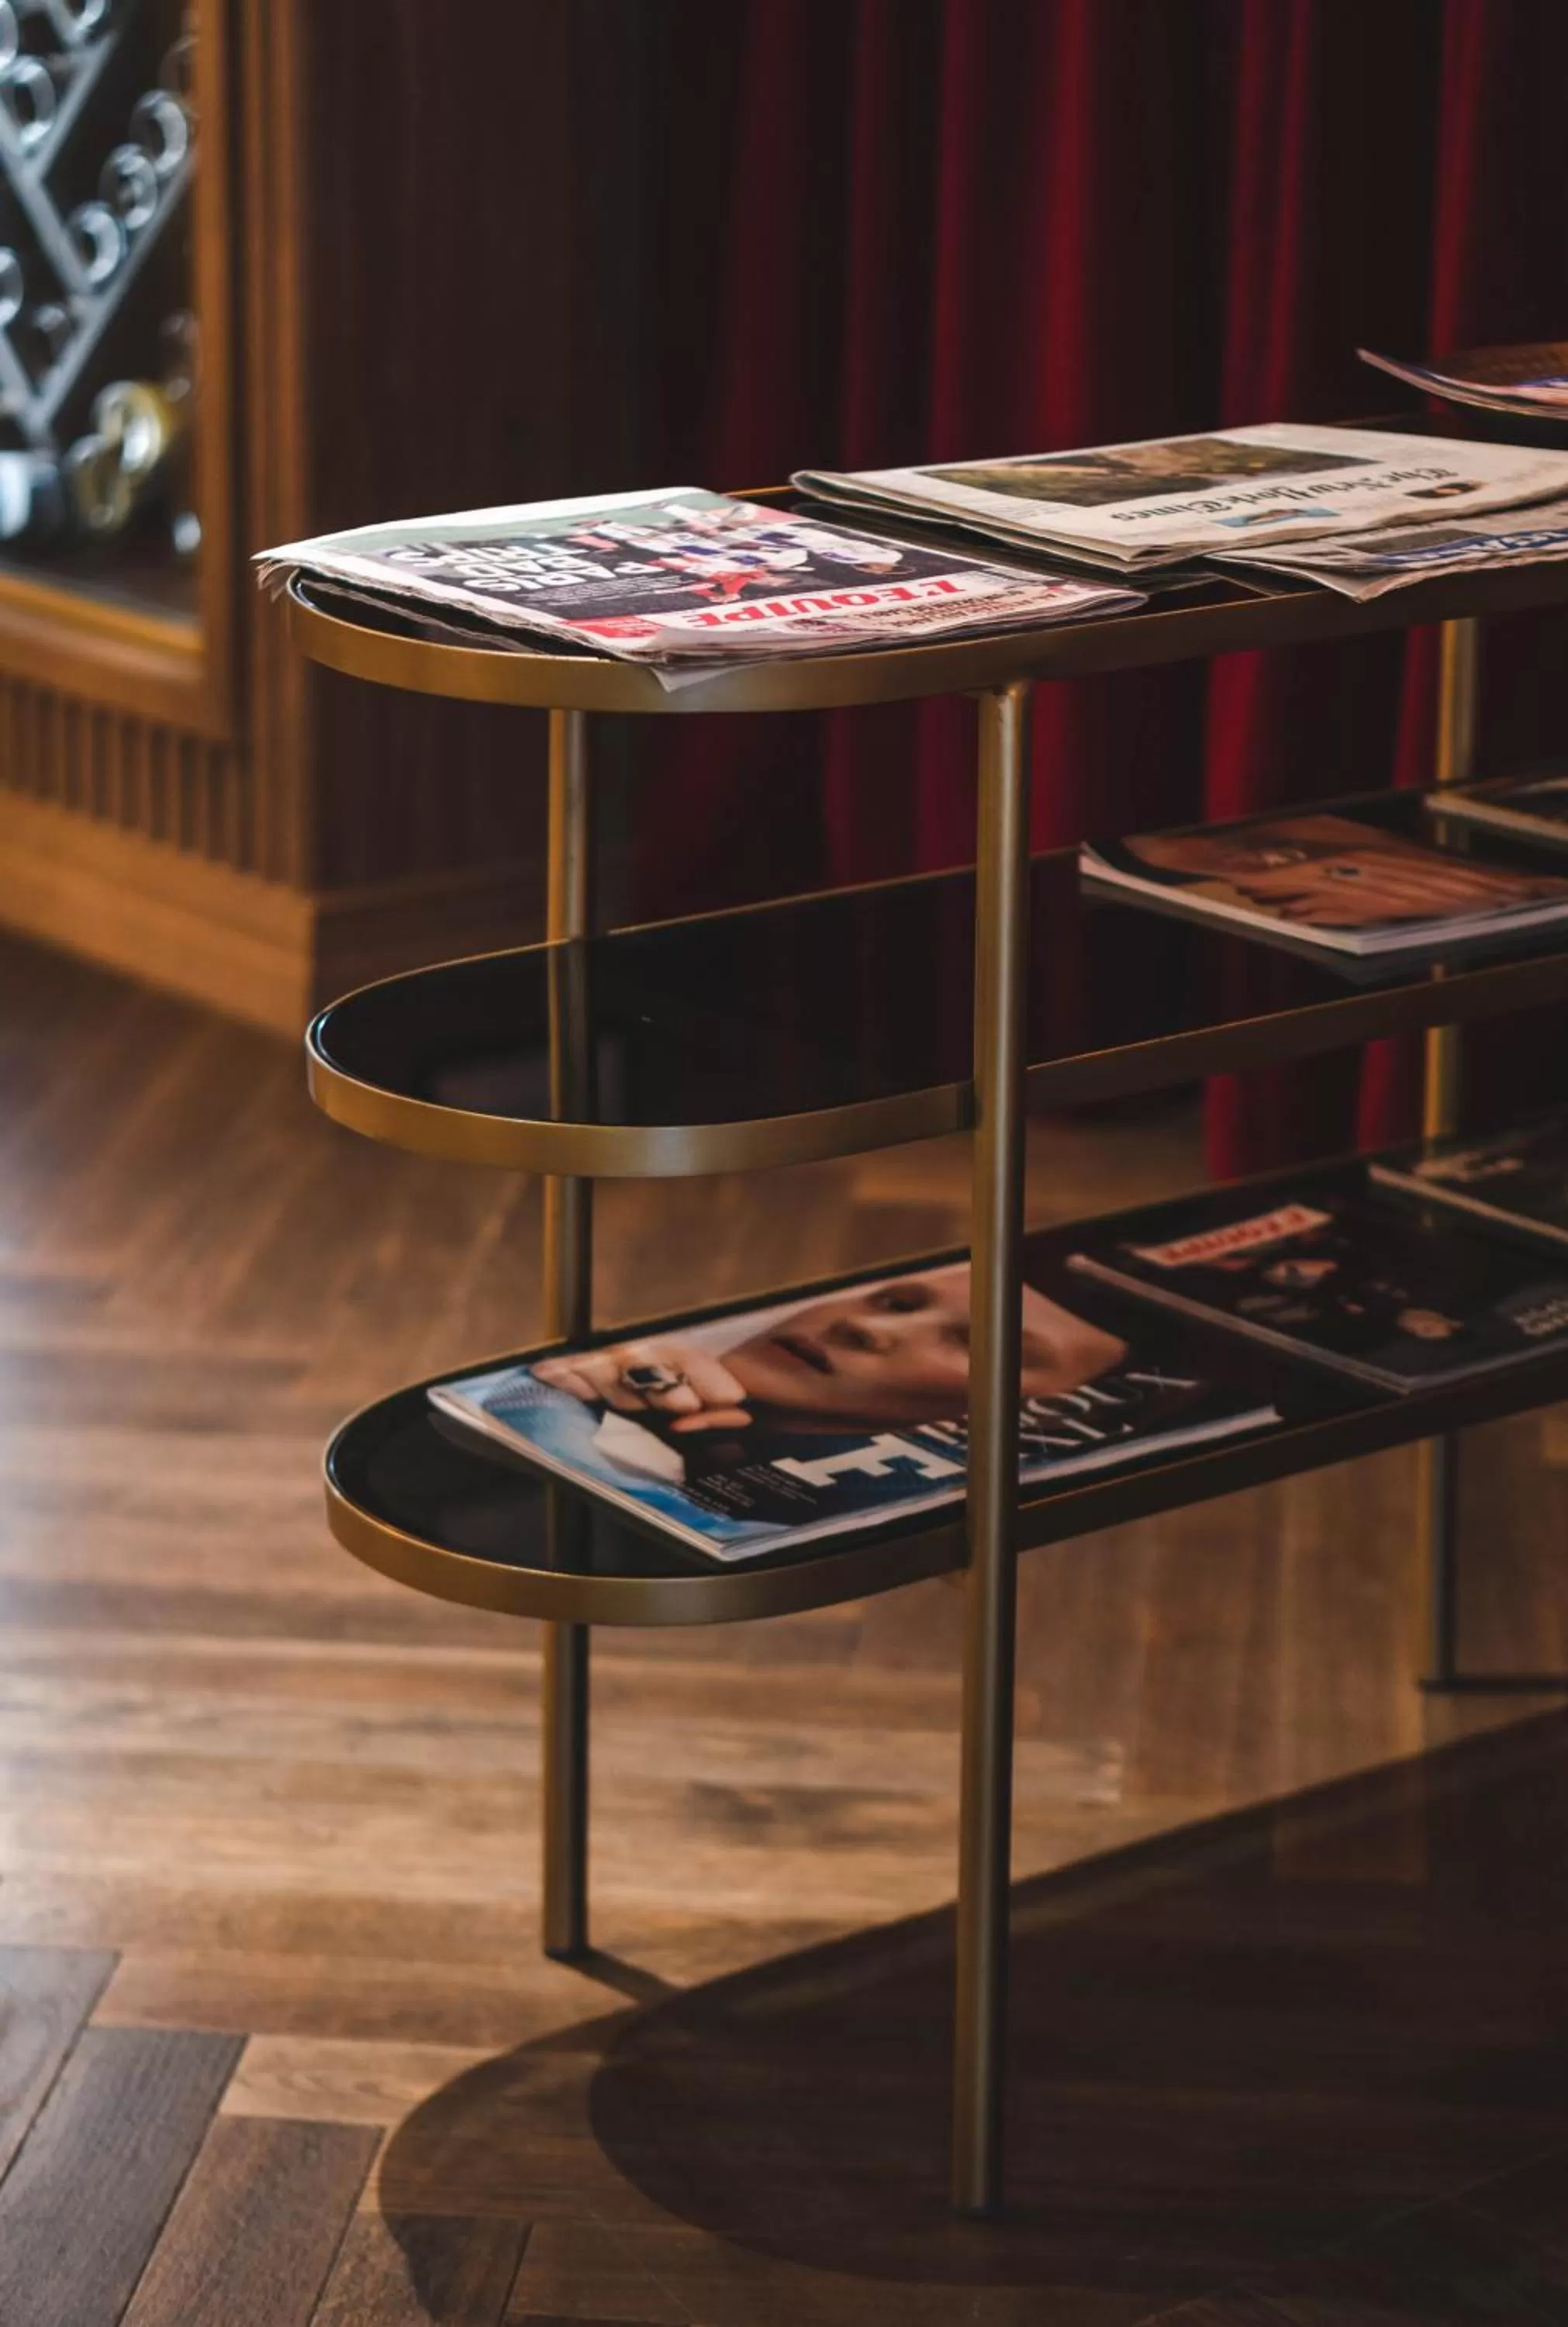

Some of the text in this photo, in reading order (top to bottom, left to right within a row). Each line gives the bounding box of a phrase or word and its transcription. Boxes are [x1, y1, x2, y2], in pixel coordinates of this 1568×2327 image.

[1110, 469, 1457, 523] The New York Times
[389, 544, 589, 567] TRIPS
[454, 555, 596, 576] BAD
[462, 562, 664, 592] PARIS
